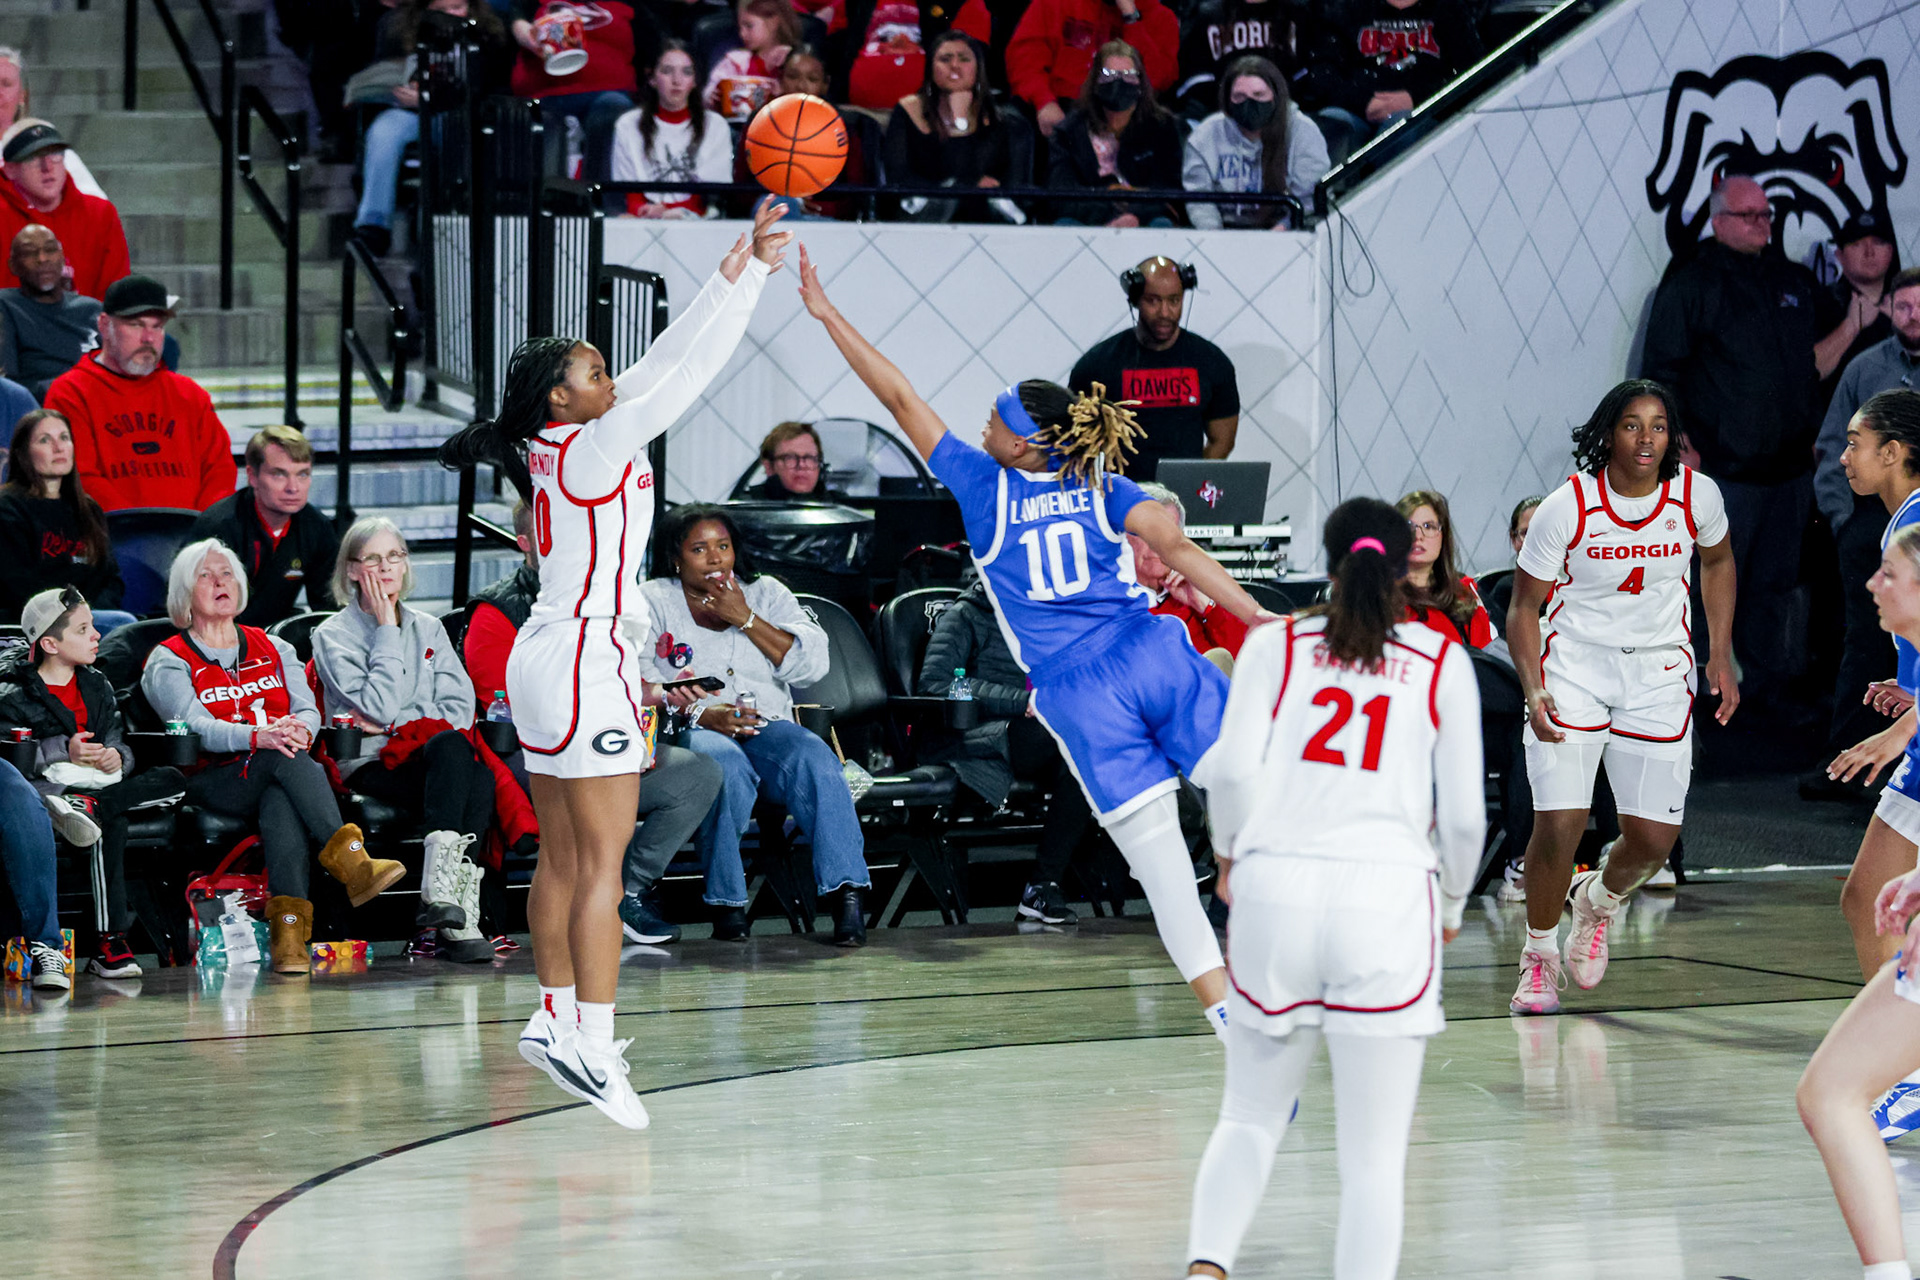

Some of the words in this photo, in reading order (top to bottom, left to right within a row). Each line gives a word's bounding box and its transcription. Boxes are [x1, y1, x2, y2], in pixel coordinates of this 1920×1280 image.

[1130, 375, 1193, 399] DAWGS
[1010, 487, 1092, 525] LAWRENCE
[1018, 520, 1092, 602] 10
[1586, 541, 1683, 560] GEORGIA
[1617, 565, 1645, 596] 4
[247, 696, 268, 729] 1
[1301, 686, 1392, 773] 21
